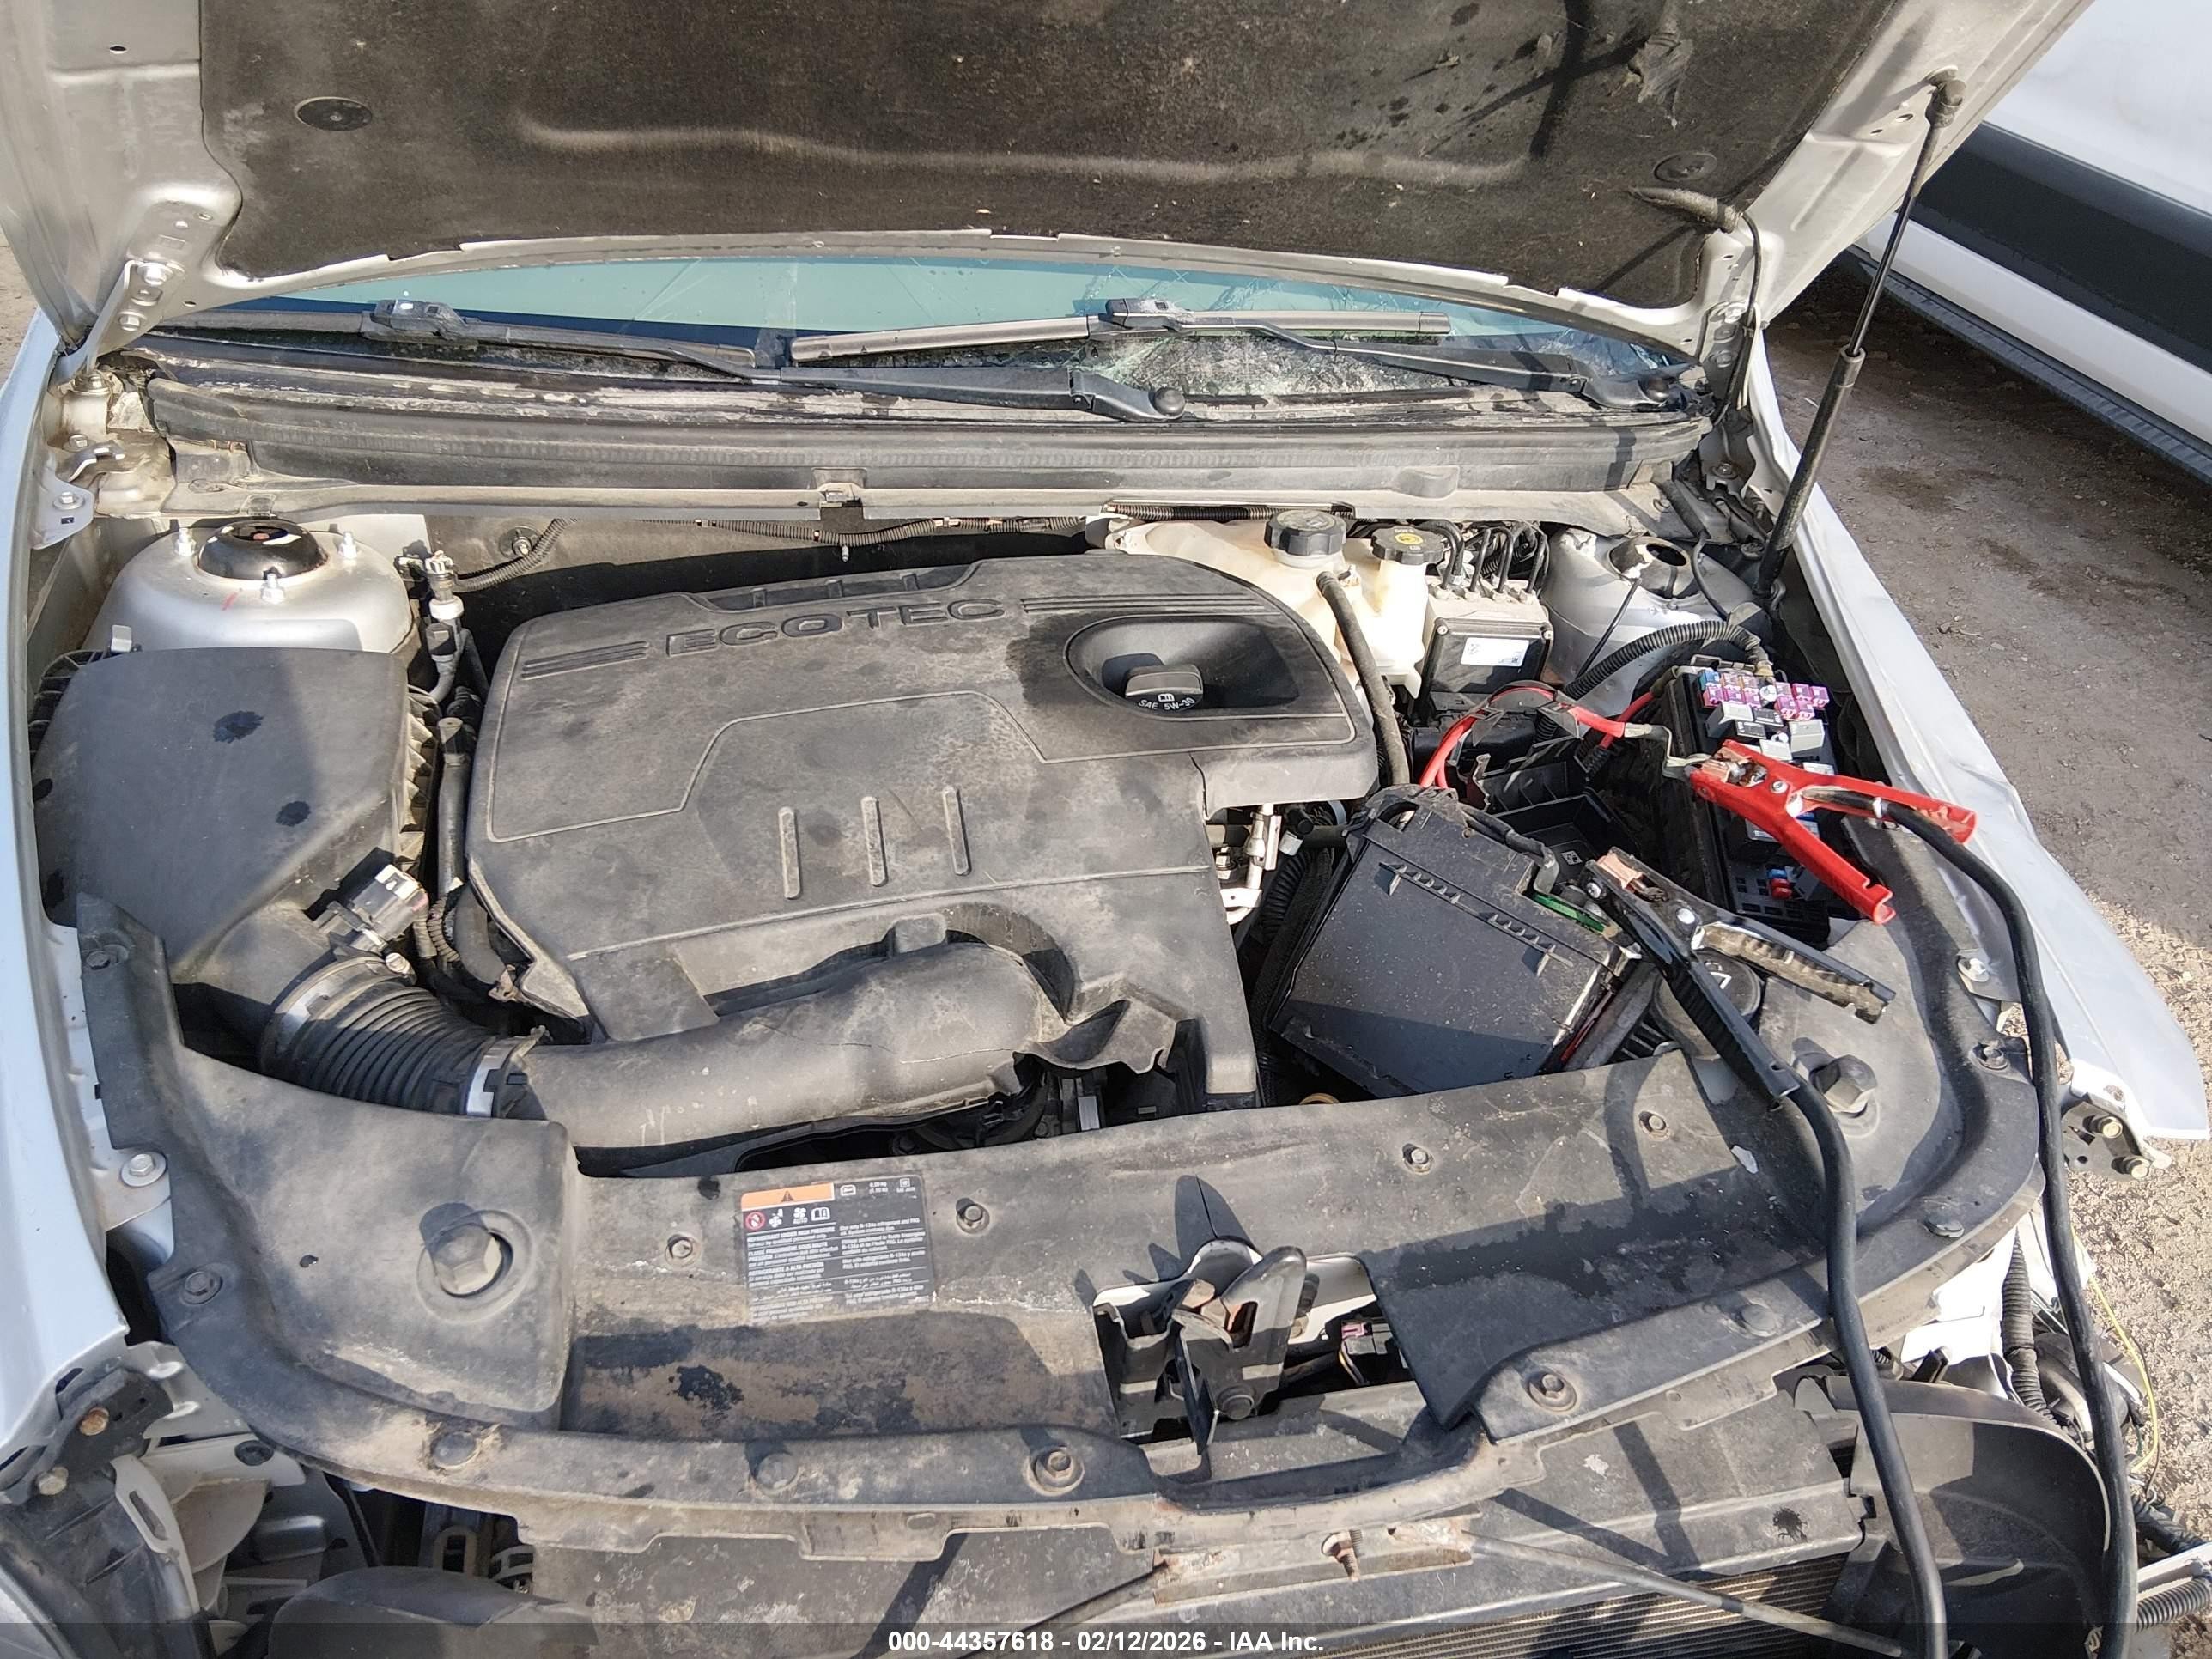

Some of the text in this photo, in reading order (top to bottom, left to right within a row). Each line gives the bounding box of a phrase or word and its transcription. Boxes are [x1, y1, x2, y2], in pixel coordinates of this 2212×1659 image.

[666, 599, 1005, 657] ECOTEC
[1138, 697, 1195, 711] SAE 5W-30
